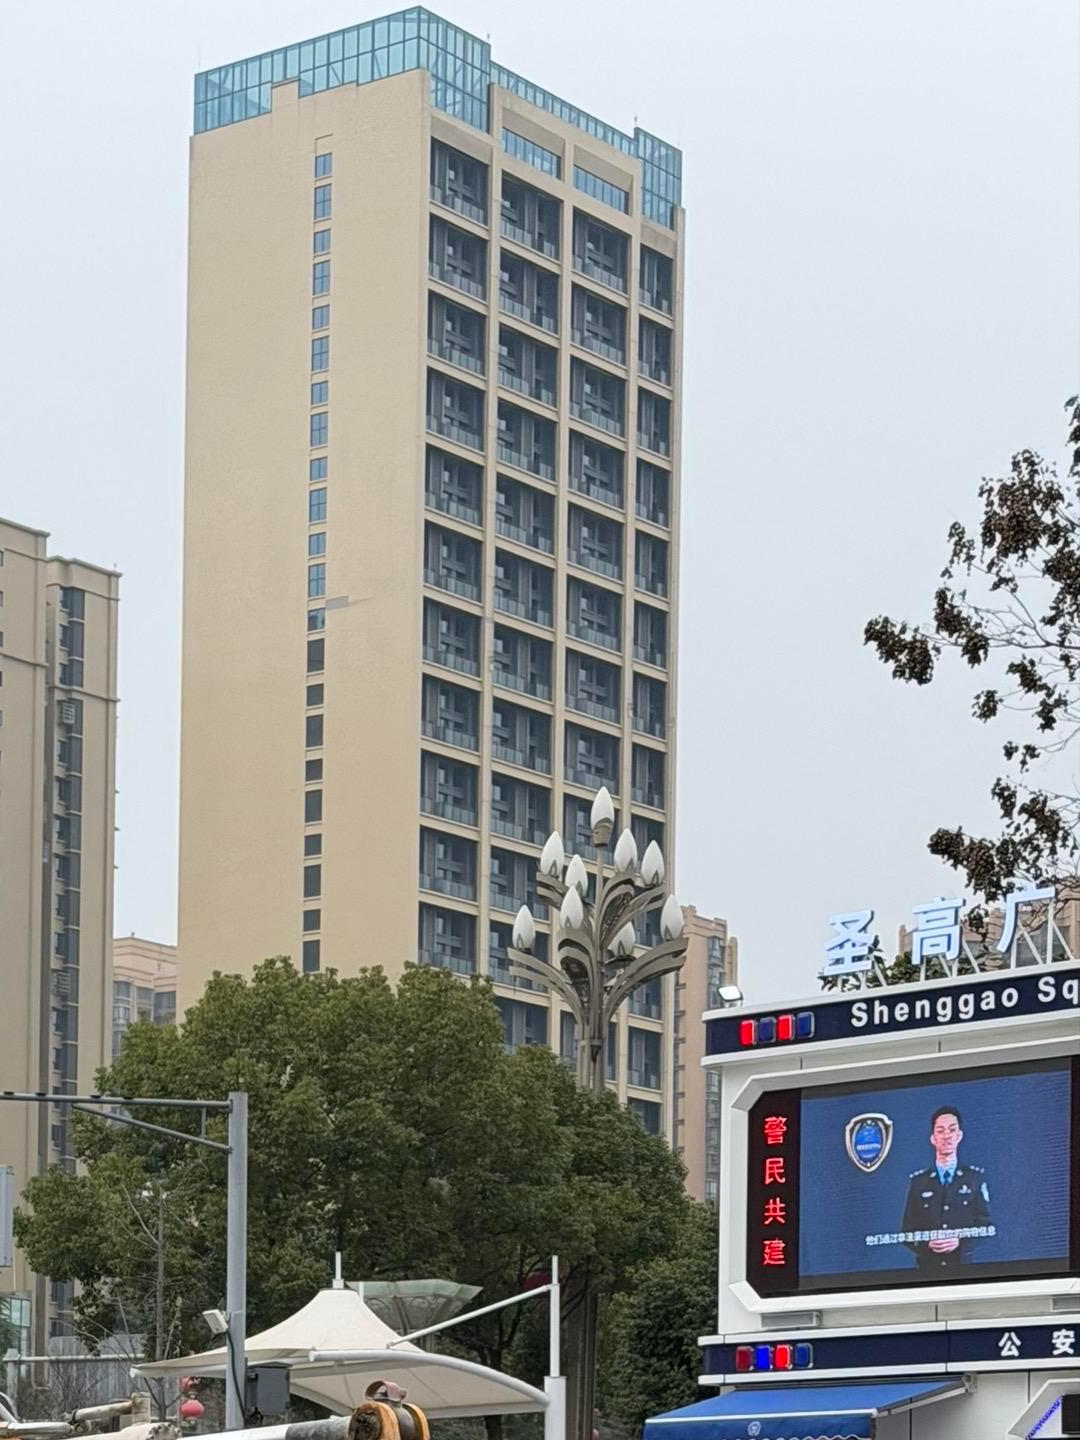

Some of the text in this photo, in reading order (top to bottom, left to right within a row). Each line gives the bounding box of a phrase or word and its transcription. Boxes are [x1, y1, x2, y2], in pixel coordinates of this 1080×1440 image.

[823, 882, 1056, 976] 圣高广
[851, 988, 1019, 1028] Shenggao
[764, 1115, 788, 1265] 警民共建
[998, 1329, 1075, 1357] 公安
